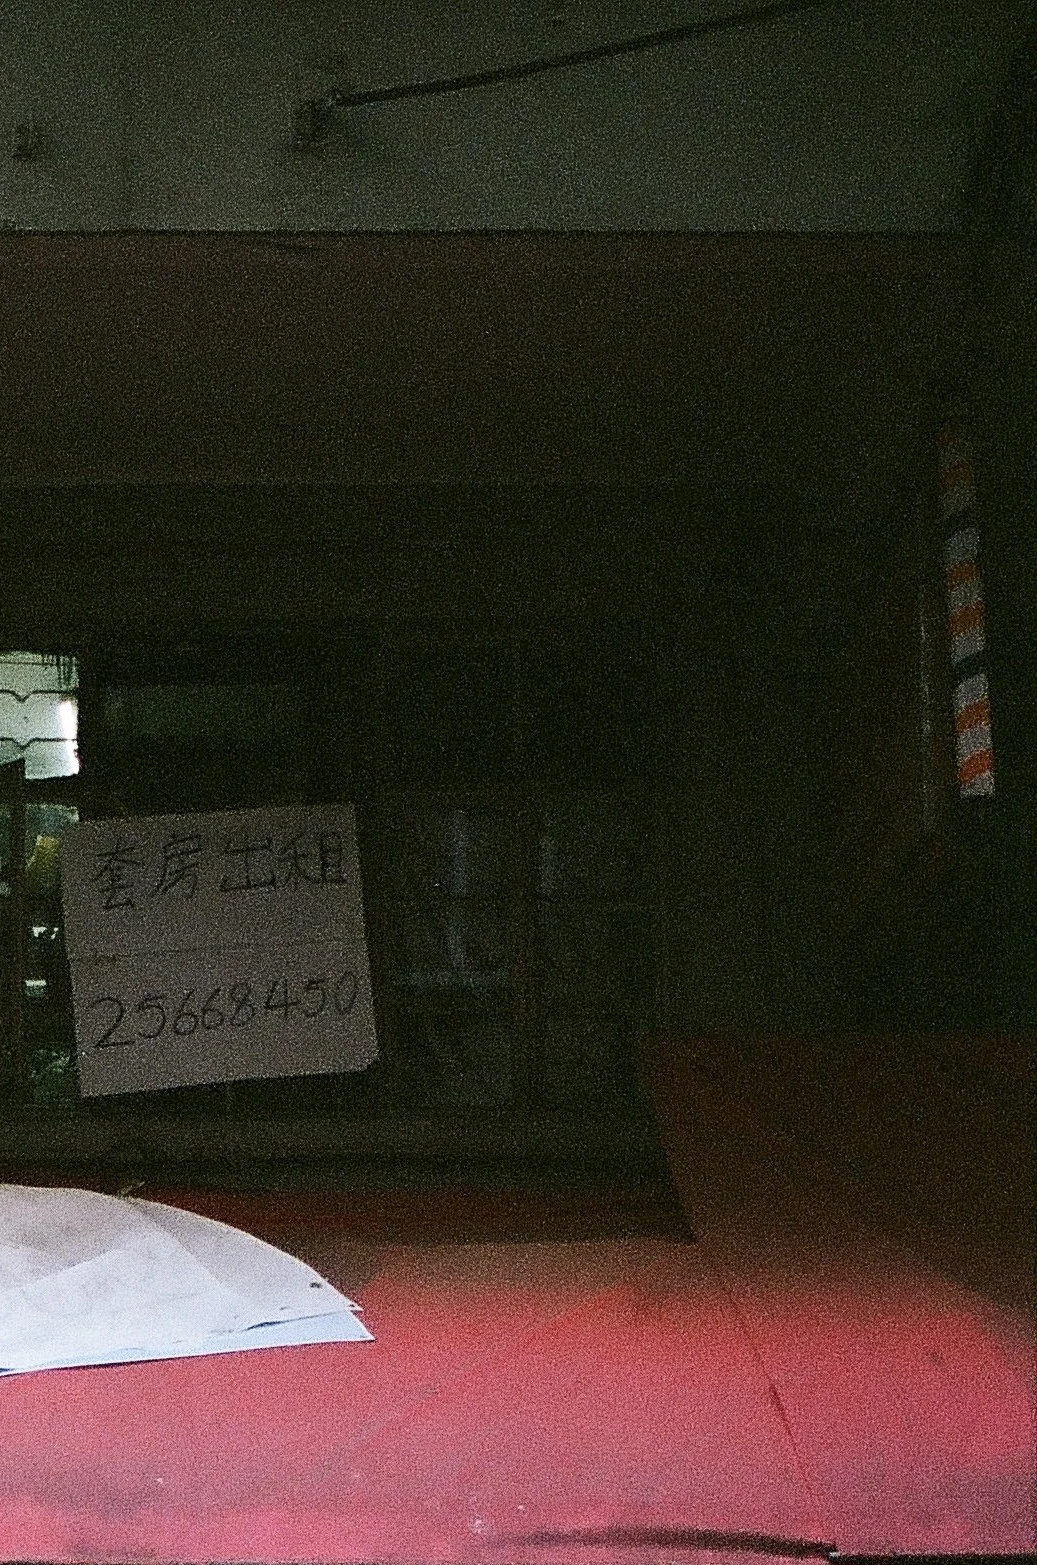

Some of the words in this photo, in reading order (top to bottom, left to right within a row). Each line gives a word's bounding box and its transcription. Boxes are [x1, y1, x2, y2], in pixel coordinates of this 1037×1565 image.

[92, 830, 350, 910] 套房出租
[91, 970, 358, 1048] 25668450
